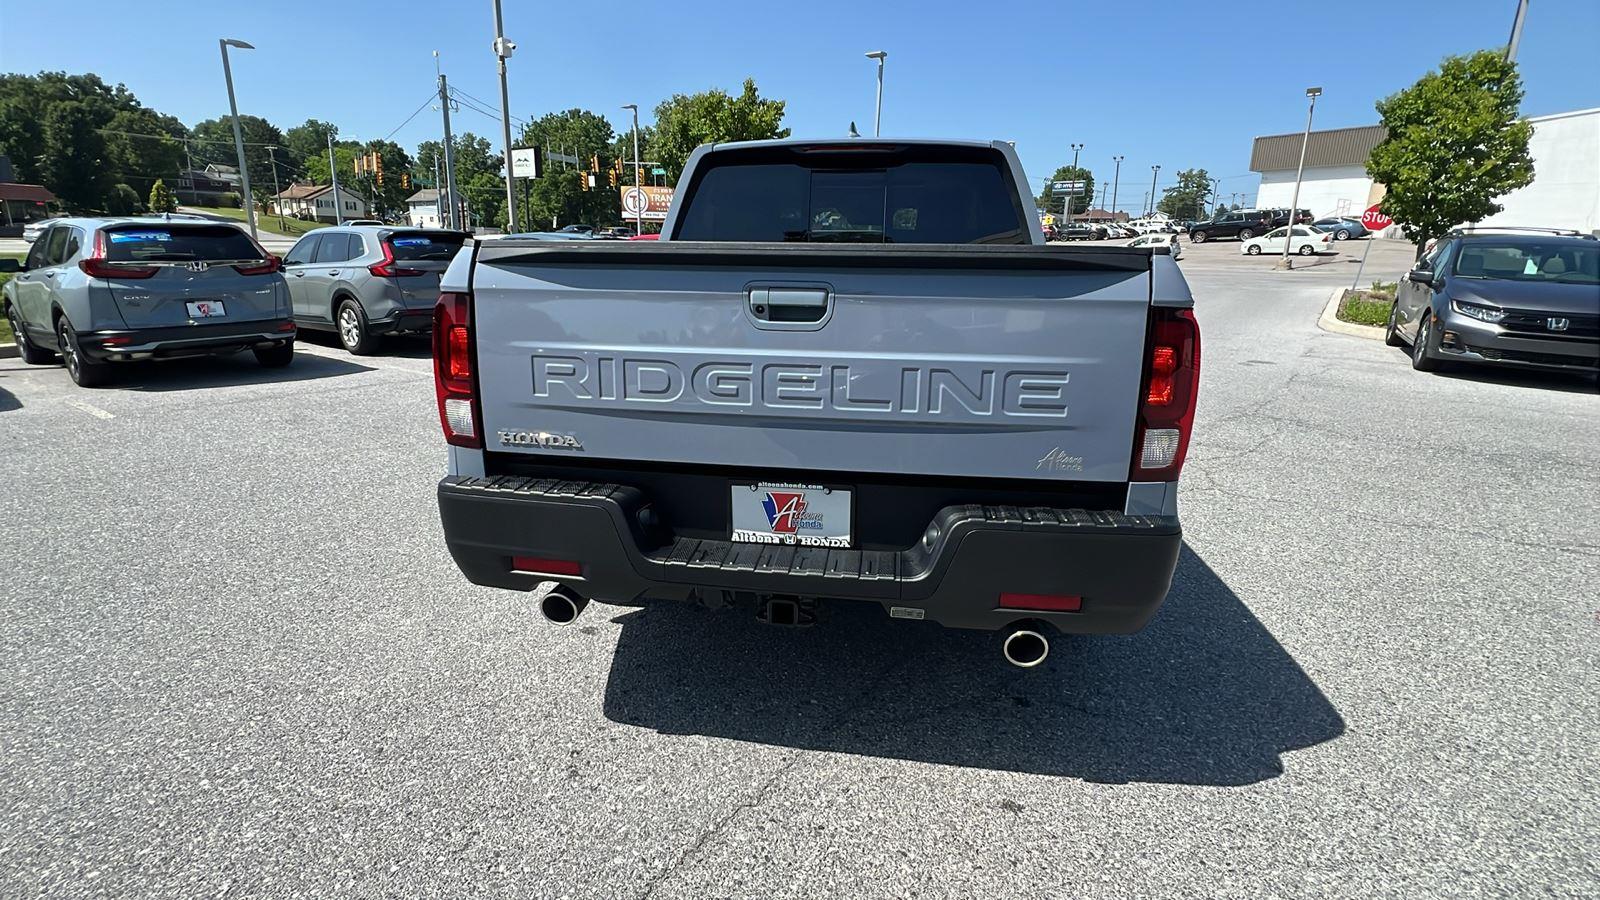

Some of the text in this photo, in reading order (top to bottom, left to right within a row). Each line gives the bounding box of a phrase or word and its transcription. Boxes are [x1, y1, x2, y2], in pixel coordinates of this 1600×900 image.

[531, 355, 1071, 417] RIDGELINE
[498, 431, 583, 449] HONDA
[757, 482, 824, 490] altoonahonda.com
[792, 519, 824, 530] Honda
[731, 532, 851, 548] Altoona HONDA
